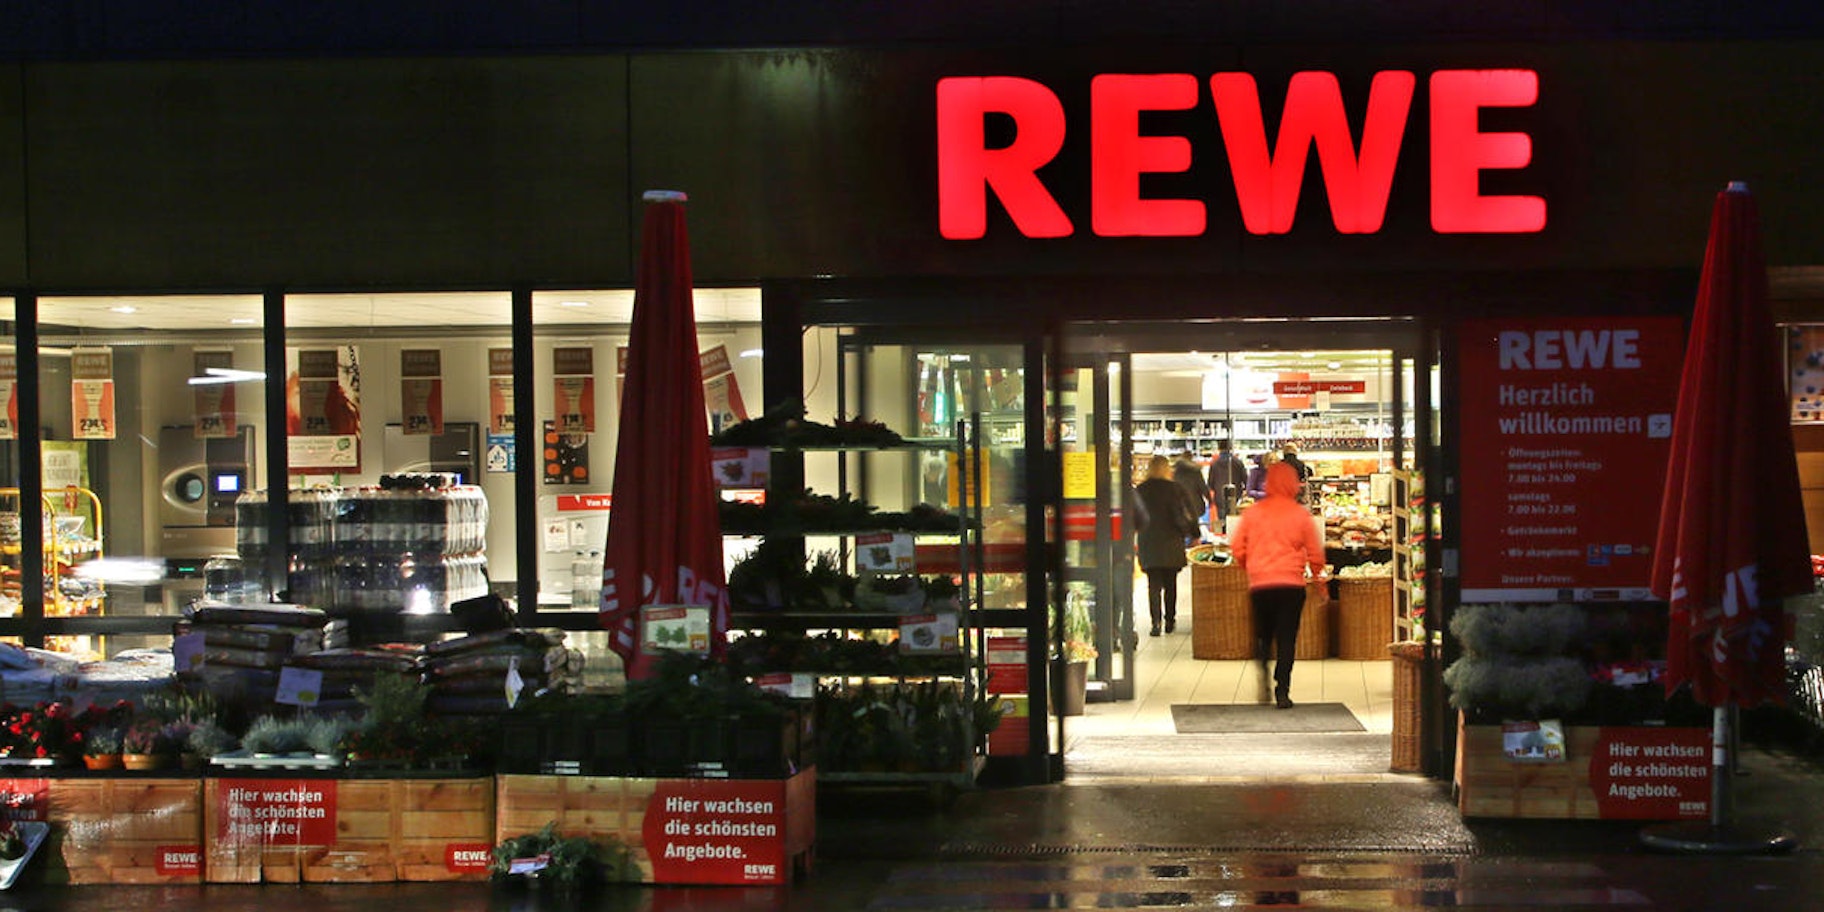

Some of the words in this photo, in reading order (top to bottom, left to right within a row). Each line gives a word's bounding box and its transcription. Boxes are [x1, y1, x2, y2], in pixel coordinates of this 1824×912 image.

[937, 69, 1547, 240] REWE
[1499, 329, 1642, 370] REWE
[1499, 382, 1595, 406] Herzlich
[1499, 411, 1642, 435] willkommen
[1609, 742, 1639, 757] Hier
[1643, 743, 1704, 758] wachsen
[1609, 763, 1632, 777] die
[1635, 762, 1708, 777] schönsten
[229, 787, 258, 803] Hier
[262, 787, 323, 803] wachsen
[1609, 783, 1682, 800] Angebote.
[254, 804, 326, 820] schönsten
[665, 796, 699, 813] Hier
[704, 797, 774, 814] wachsen
[665, 821, 689, 837] die
[695, 820, 776, 837] schönsten
[164, 852, 198, 864] REWE
[453, 850, 487, 862] REWE
[664, 843, 748, 862] Angebote.
[744, 864, 776, 876] REWE
